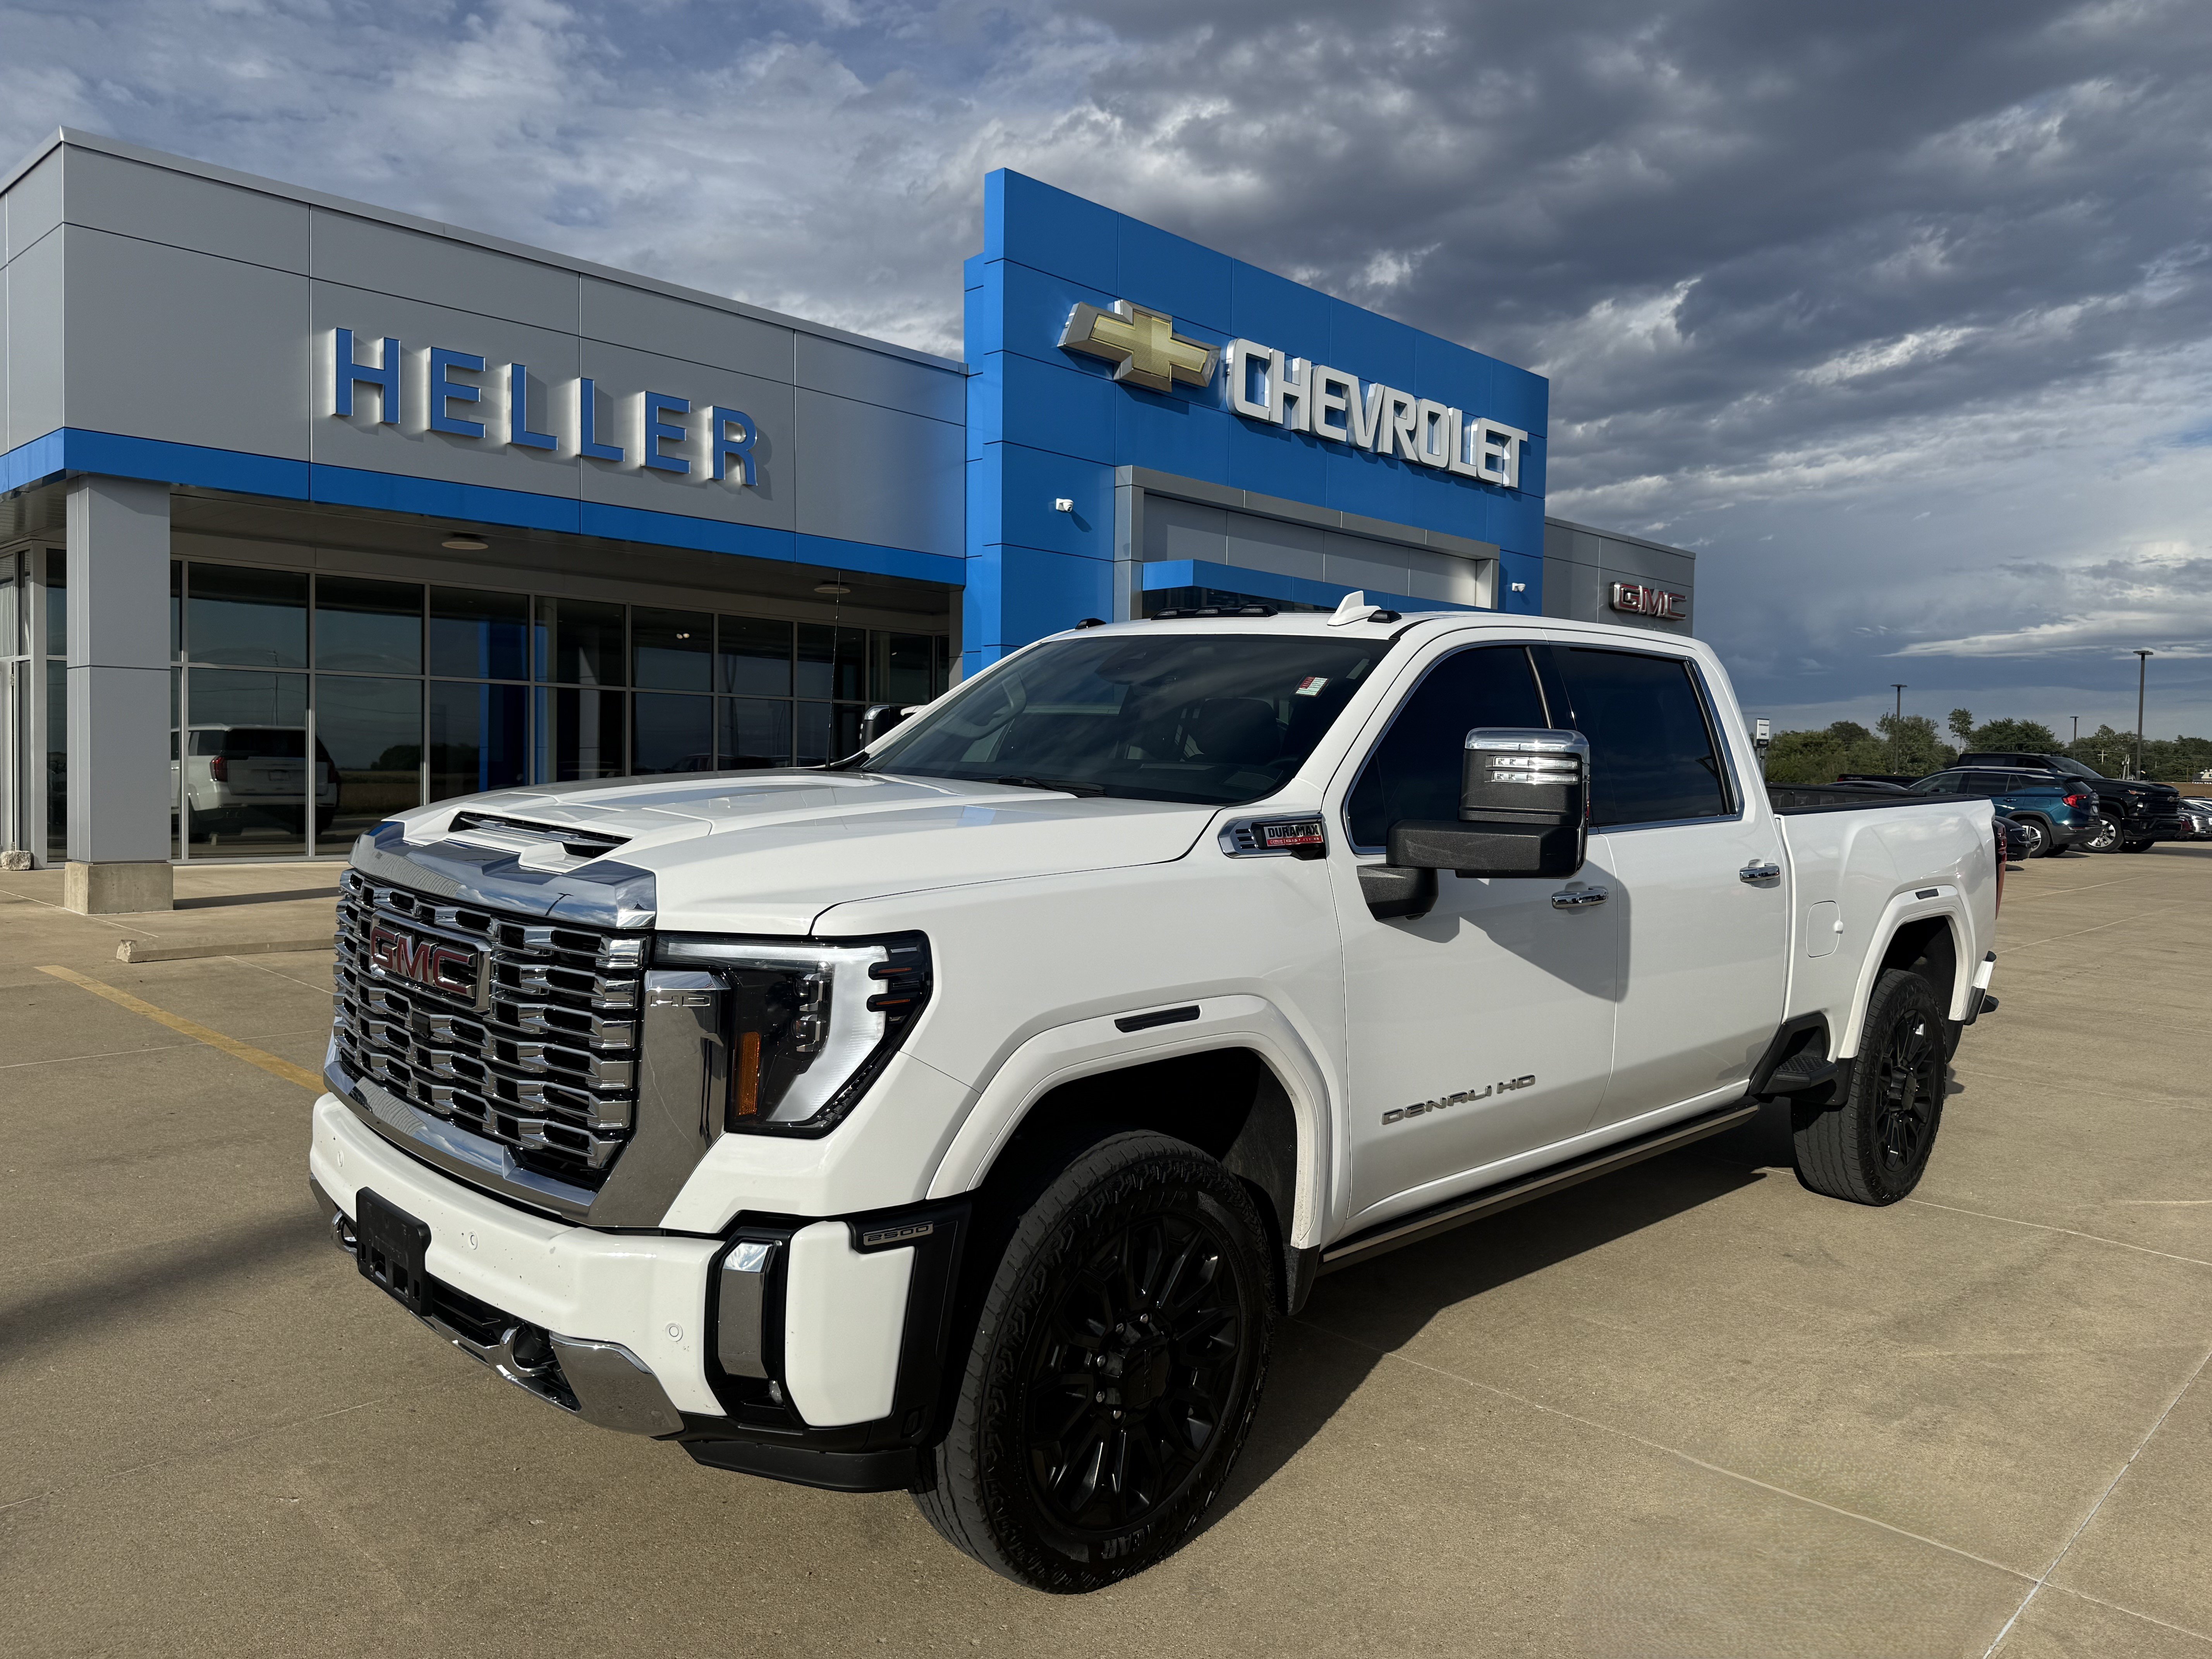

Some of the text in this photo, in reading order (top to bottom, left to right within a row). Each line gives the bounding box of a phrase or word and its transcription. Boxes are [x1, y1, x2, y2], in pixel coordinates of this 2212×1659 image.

[334, 328, 757, 486] HELLER
[1225, 338, 1528, 488] CHEVROLET
[1611, 581, 1686, 620] GMC
[1267, 824, 1319, 838] DURAMAX
[371, 924, 476, 998] GMC
[650, 995, 711, 1006] HD
[1381, 1073, 1536, 1125] DENALI HD
[868, 1225, 929, 1242] 2500
